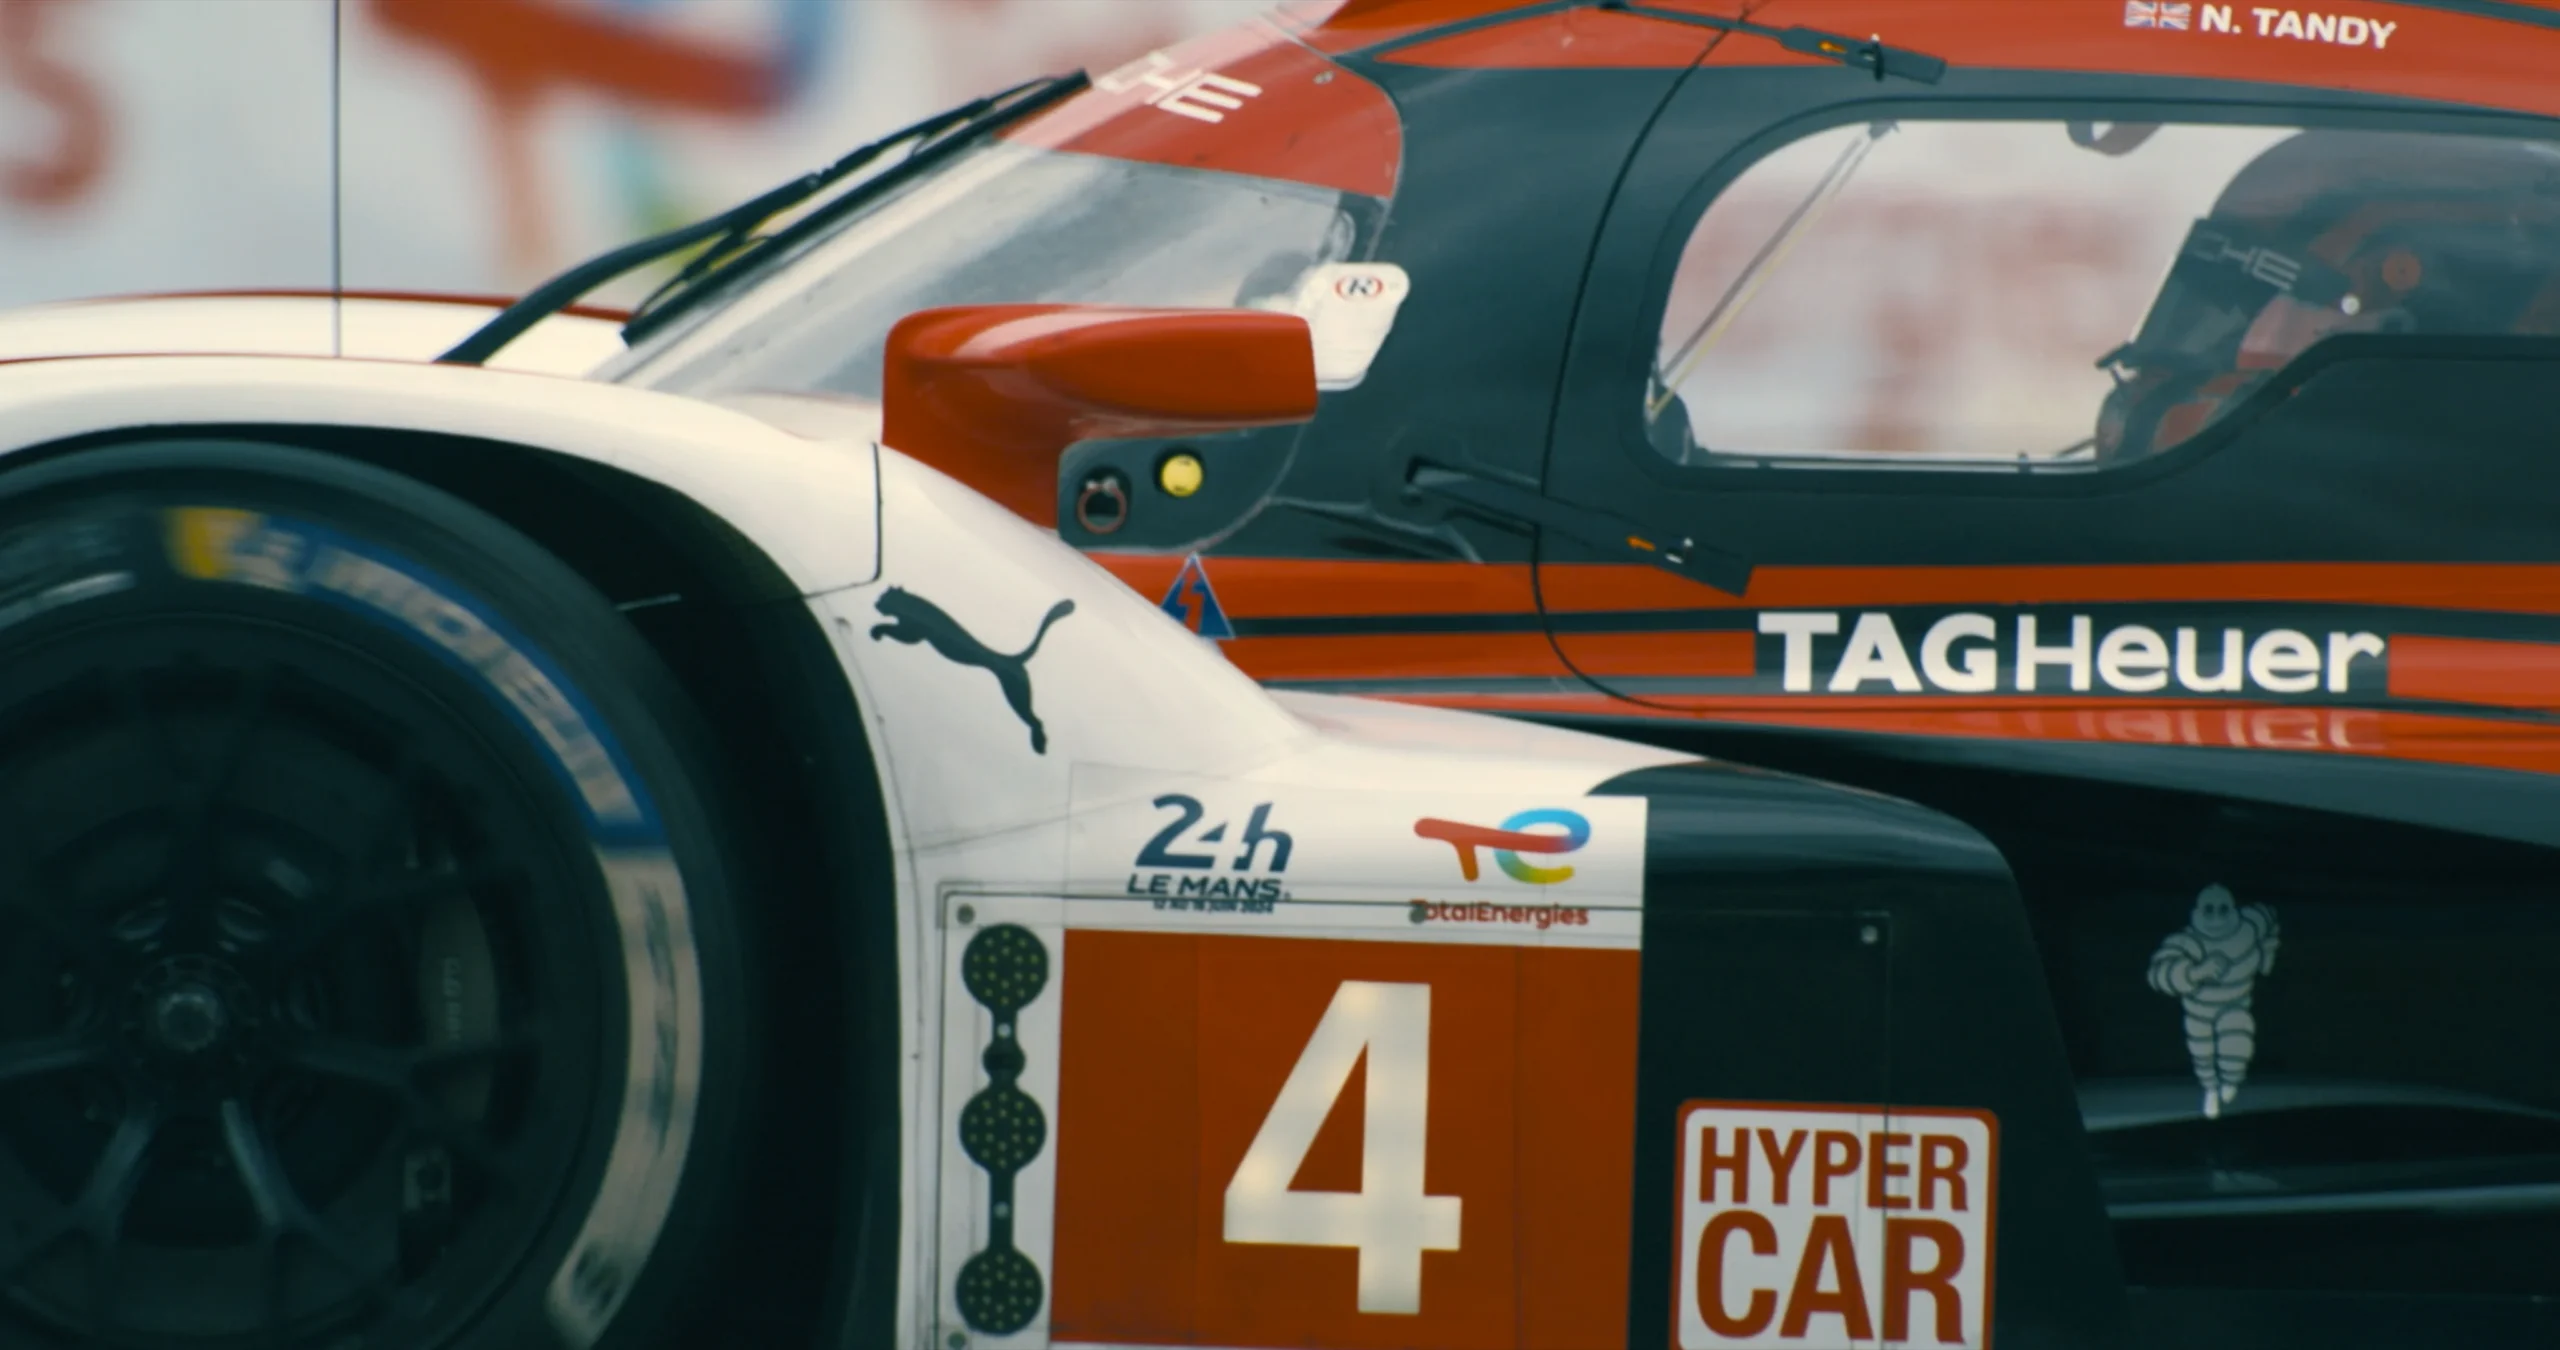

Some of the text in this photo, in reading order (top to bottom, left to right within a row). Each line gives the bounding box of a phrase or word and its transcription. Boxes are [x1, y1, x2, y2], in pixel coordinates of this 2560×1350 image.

[2200, 4, 2398, 49] N. TANDY
[1135, 793, 1293, 873] 24h
[1127, 873, 1283, 901] LE MANS
[1223, 979, 1462, 1316] 4
[1698, 1125, 1971, 1212] HYPER
[1696, 1208, 1967, 1345] CAR
